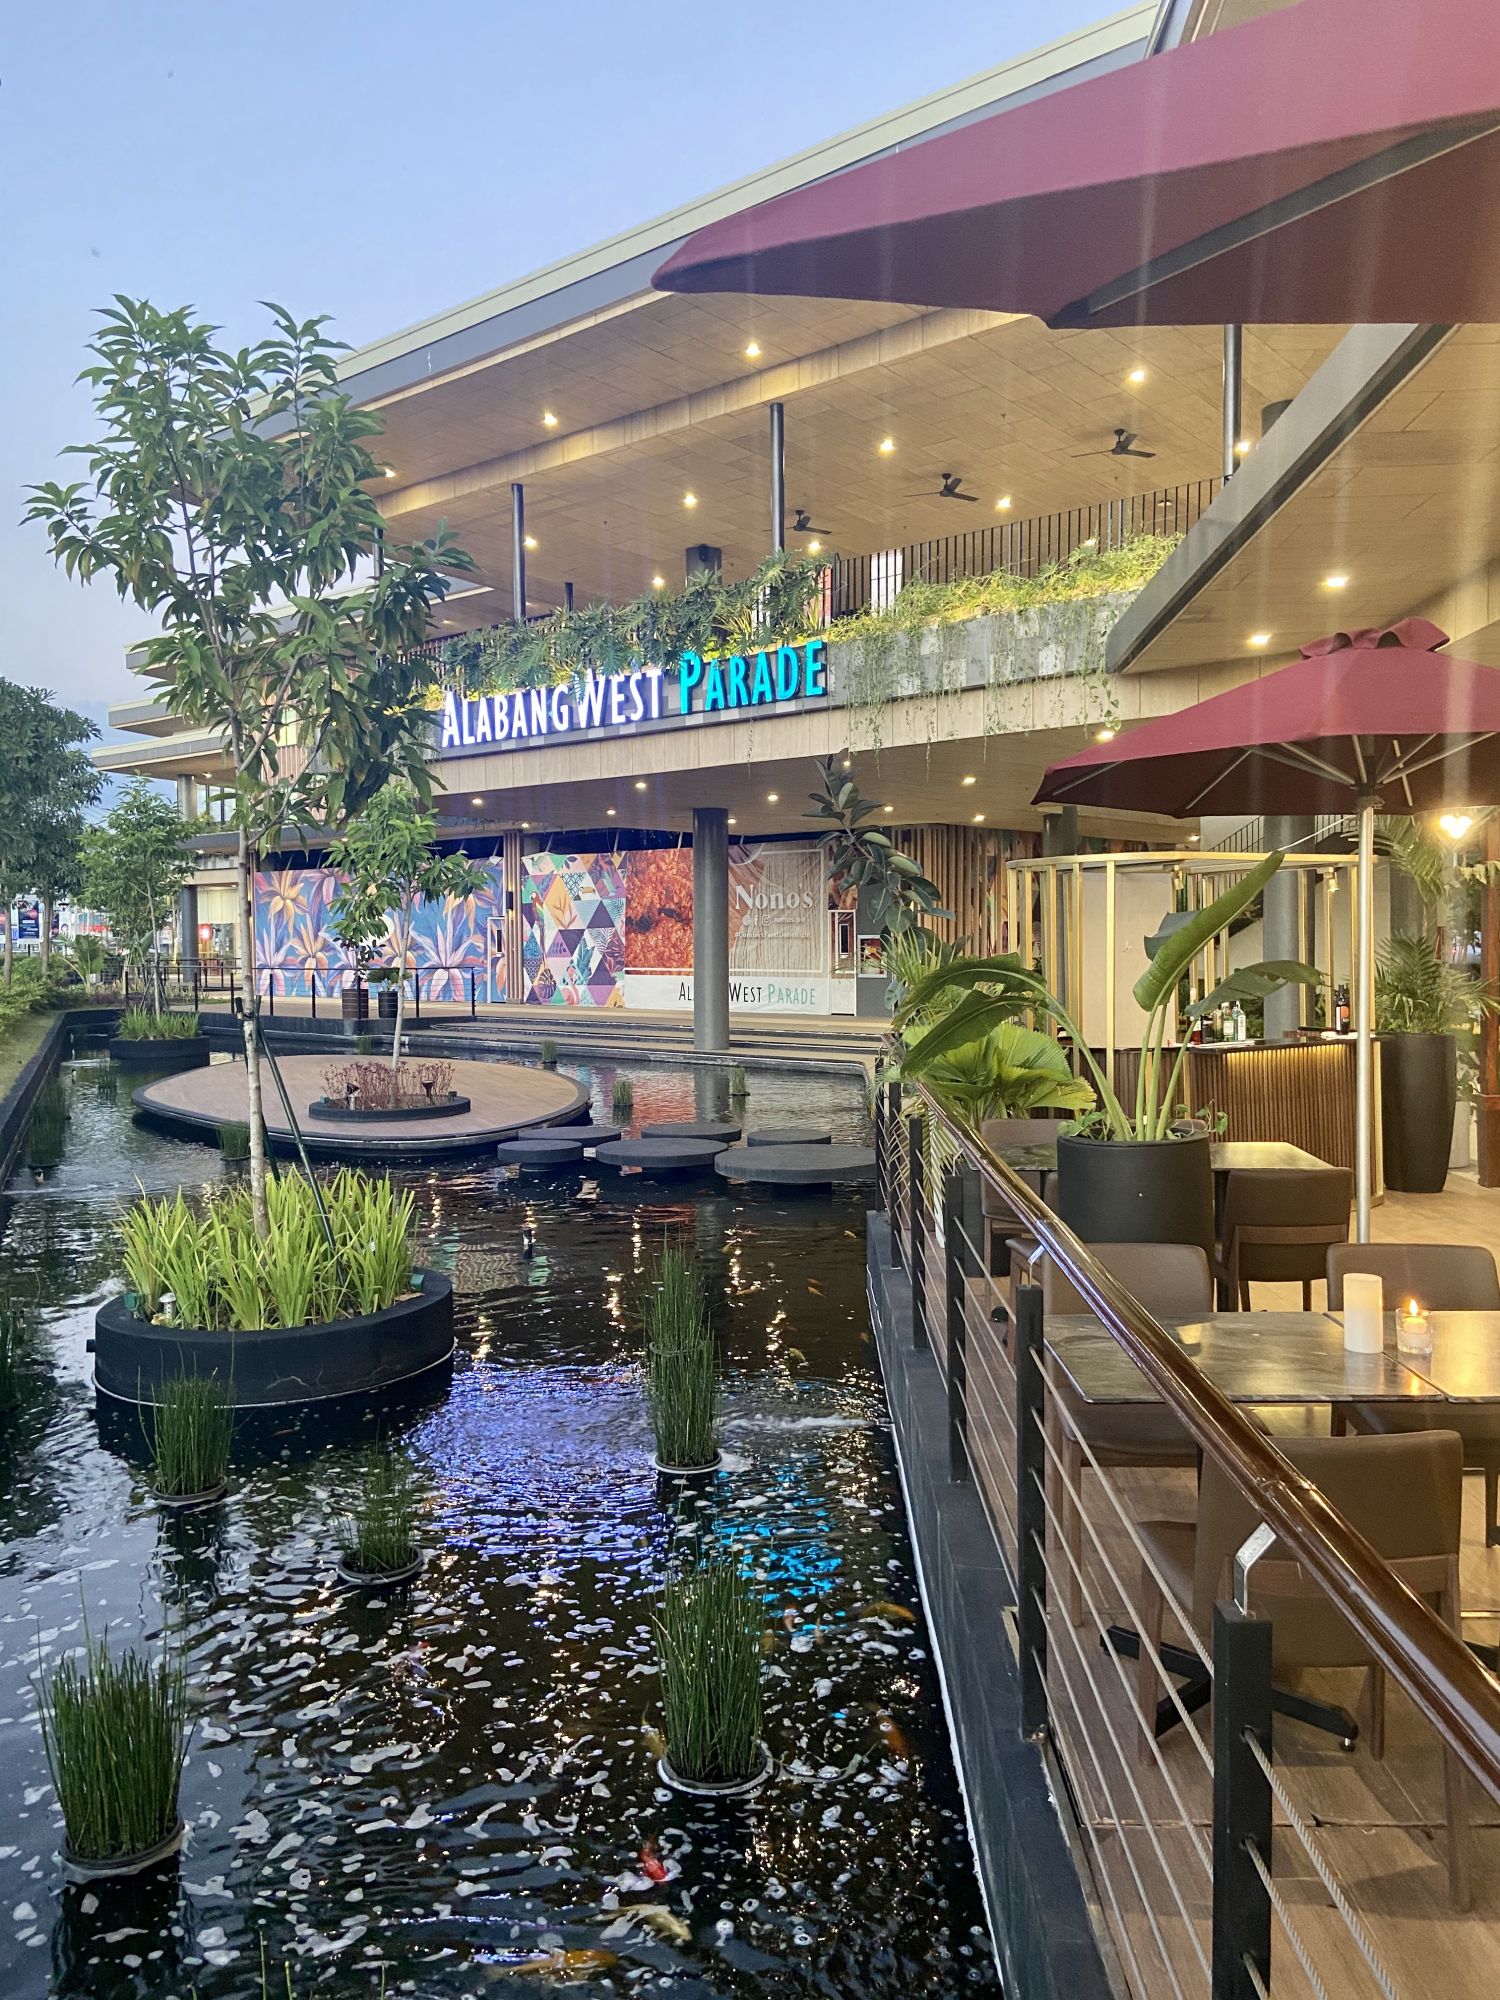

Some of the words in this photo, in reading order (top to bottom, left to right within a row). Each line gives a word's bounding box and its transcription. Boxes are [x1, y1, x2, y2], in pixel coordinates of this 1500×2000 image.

[441, 684, 570, 748] ALABANG
[573, 667, 664, 729] WEST
[680, 640, 826, 715] PARADE
[728, 982, 762, 1003] WEST
[767, 983, 816, 1005] PARADE
